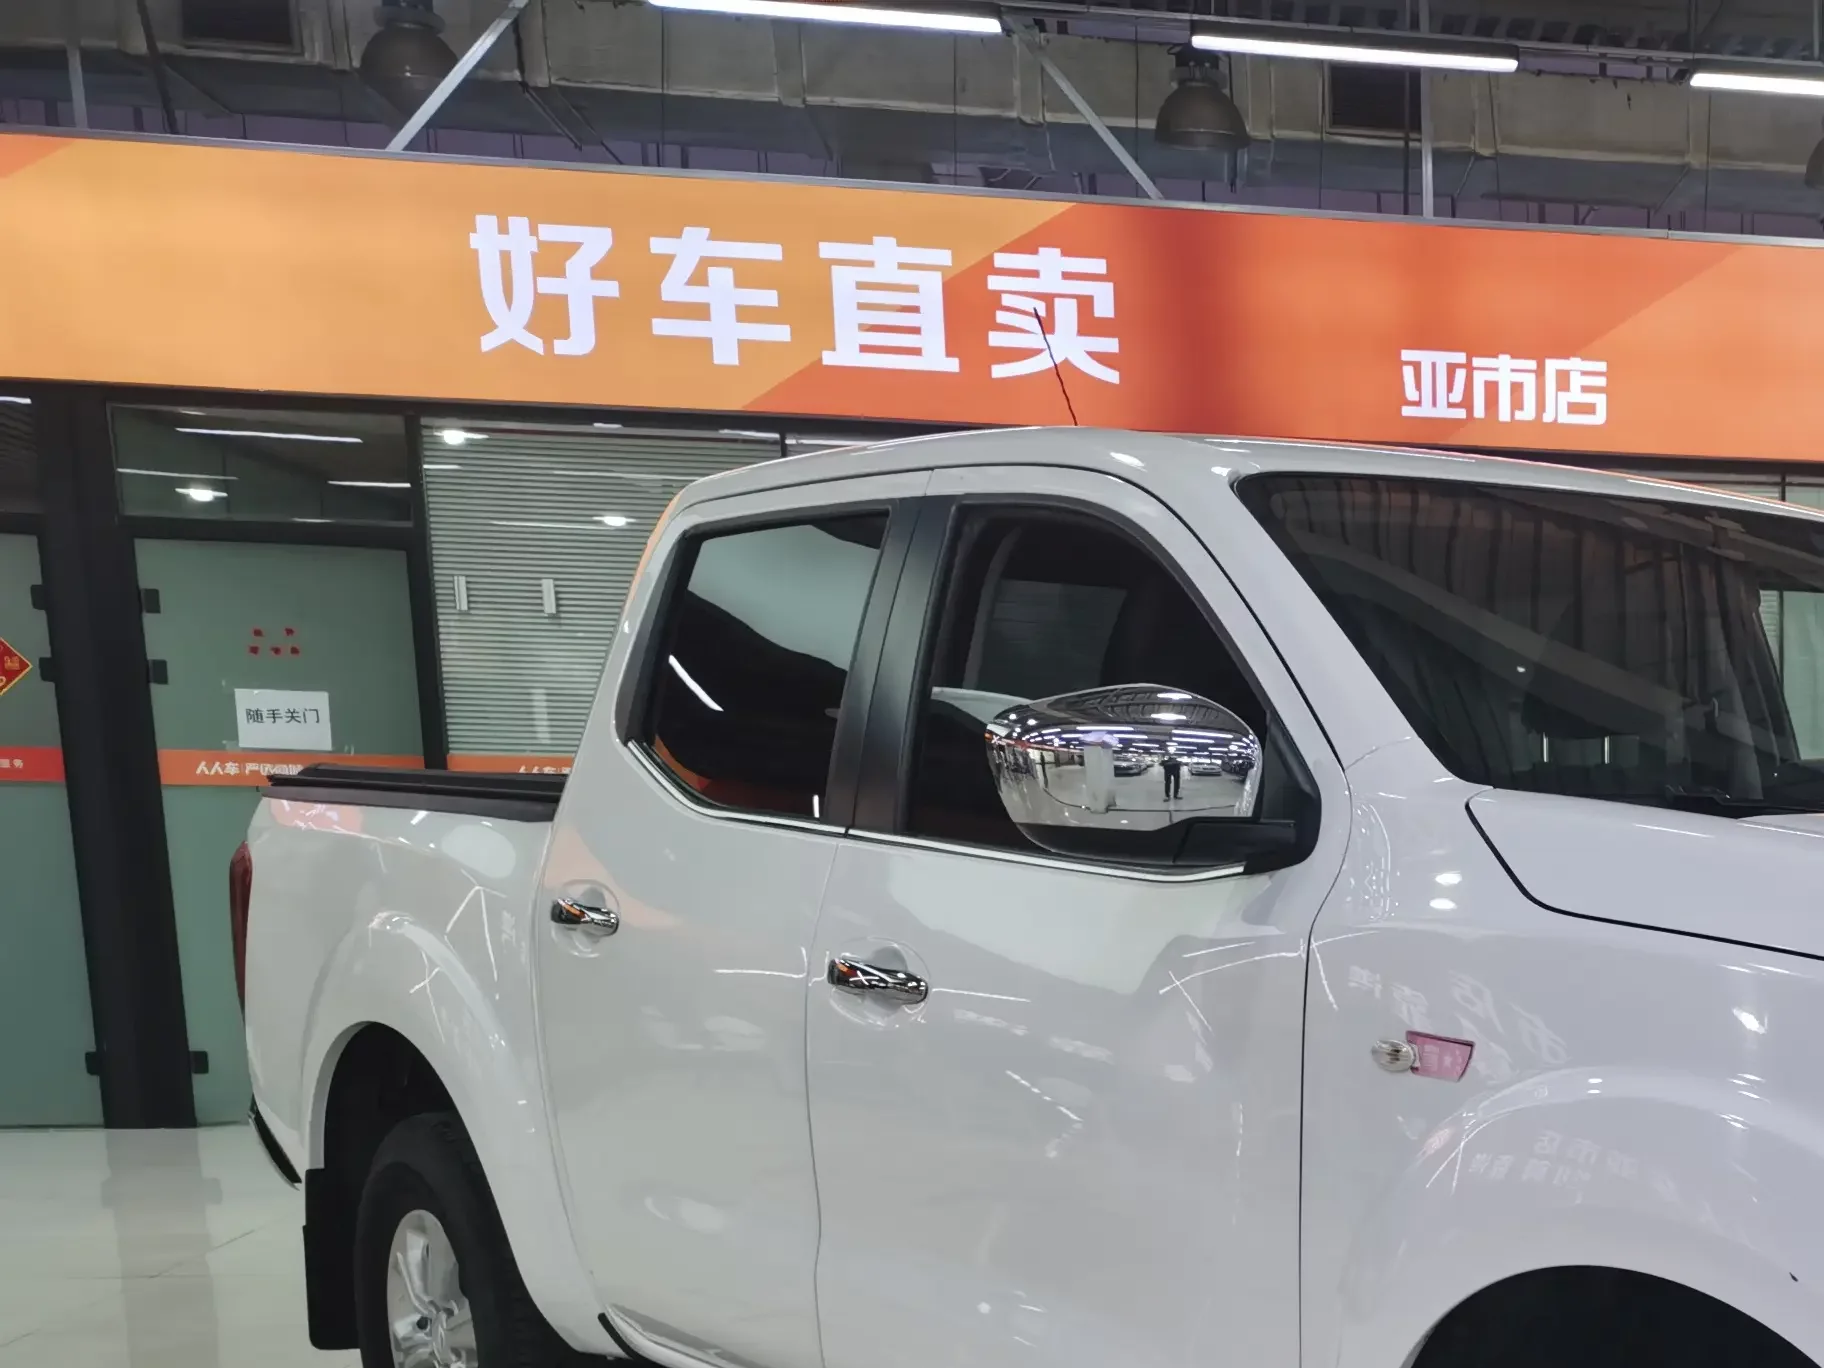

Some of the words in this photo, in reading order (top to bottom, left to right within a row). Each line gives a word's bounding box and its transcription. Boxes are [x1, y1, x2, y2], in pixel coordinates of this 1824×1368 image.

[468, 213, 1121, 385] 好车直卖
[1400, 348, 1608, 426] 亚市店
[245, 707, 320, 724] 随手关门
[196, 761, 240, 776] 人人车
